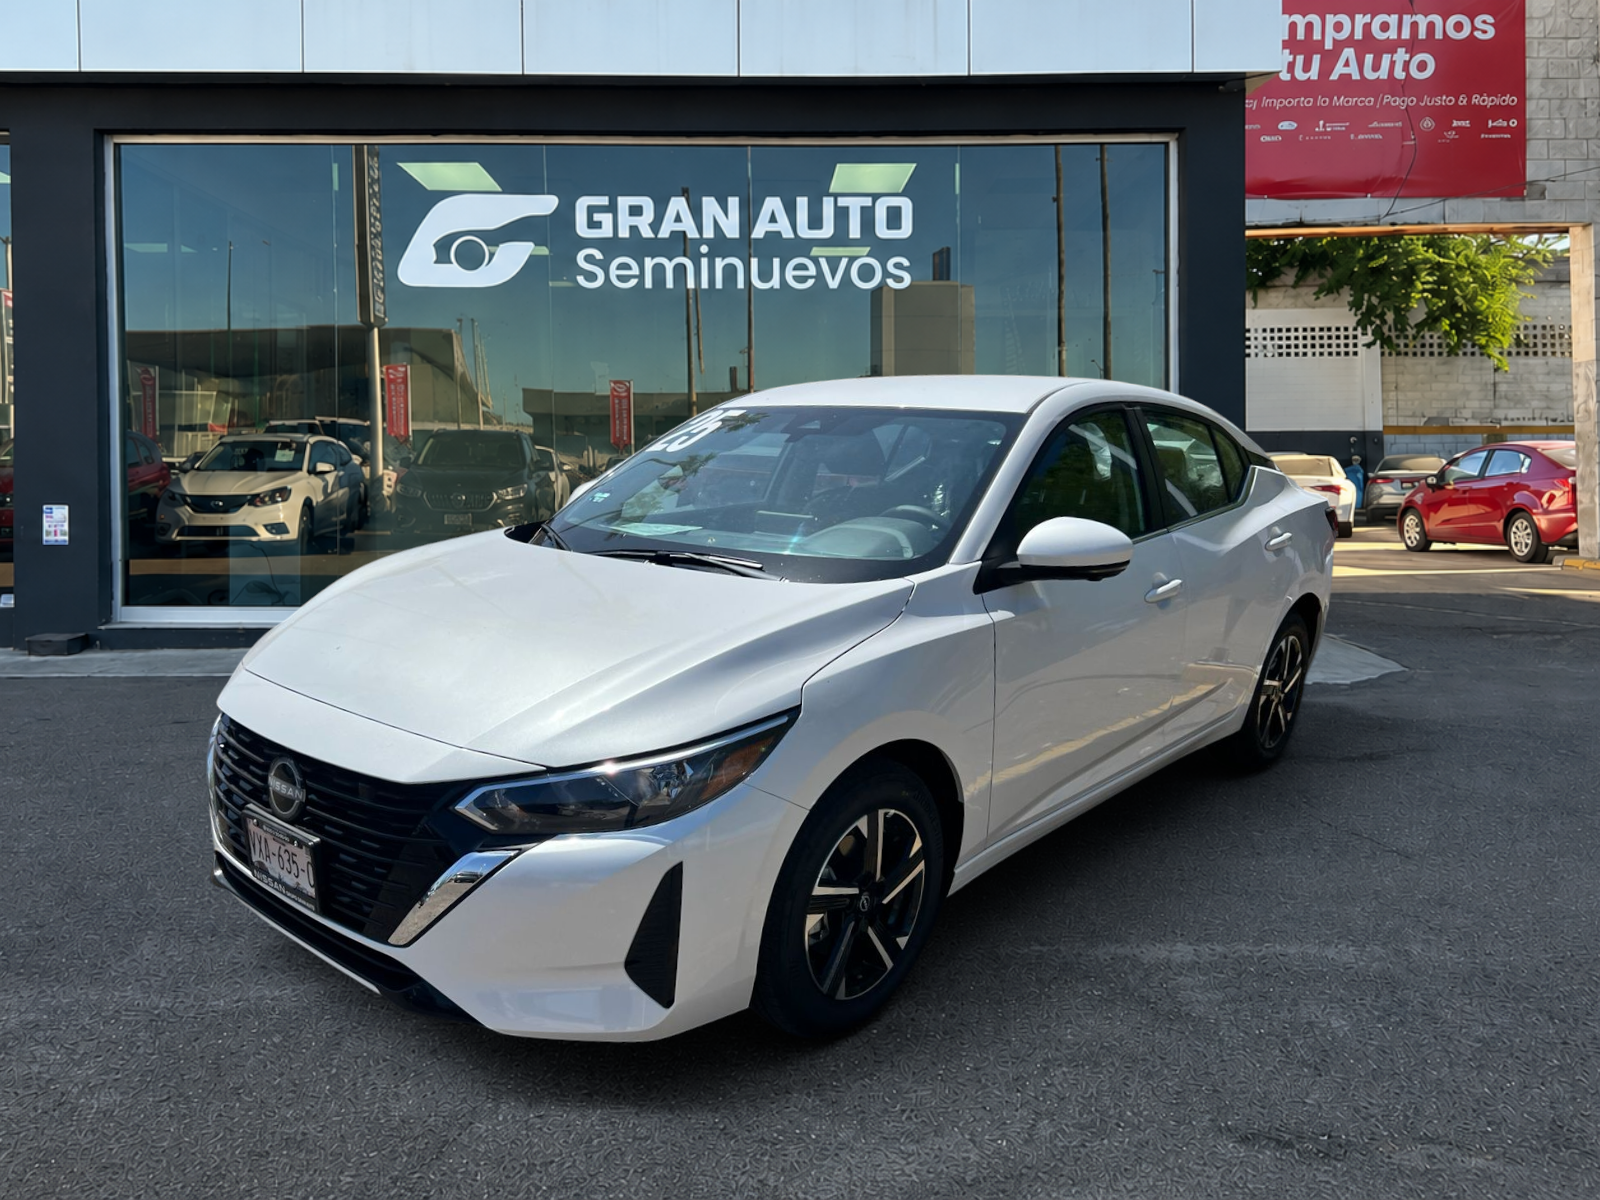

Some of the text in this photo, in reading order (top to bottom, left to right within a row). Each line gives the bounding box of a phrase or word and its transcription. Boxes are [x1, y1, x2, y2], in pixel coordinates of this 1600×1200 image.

[1279, 47, 1436, 81] tu Auto
[1261, 95, 1314, 110] Importa
[1332, 95, 1374, 107] Marca
[1419, 94, 1456, 107] Justo
[1457, 94, 1468, 106] &
[575, 195, 914, 239] GRAN AUTO
[575, 245, 913, 291] Seminuevos
[253, 869, 286, 894] NISSAN
